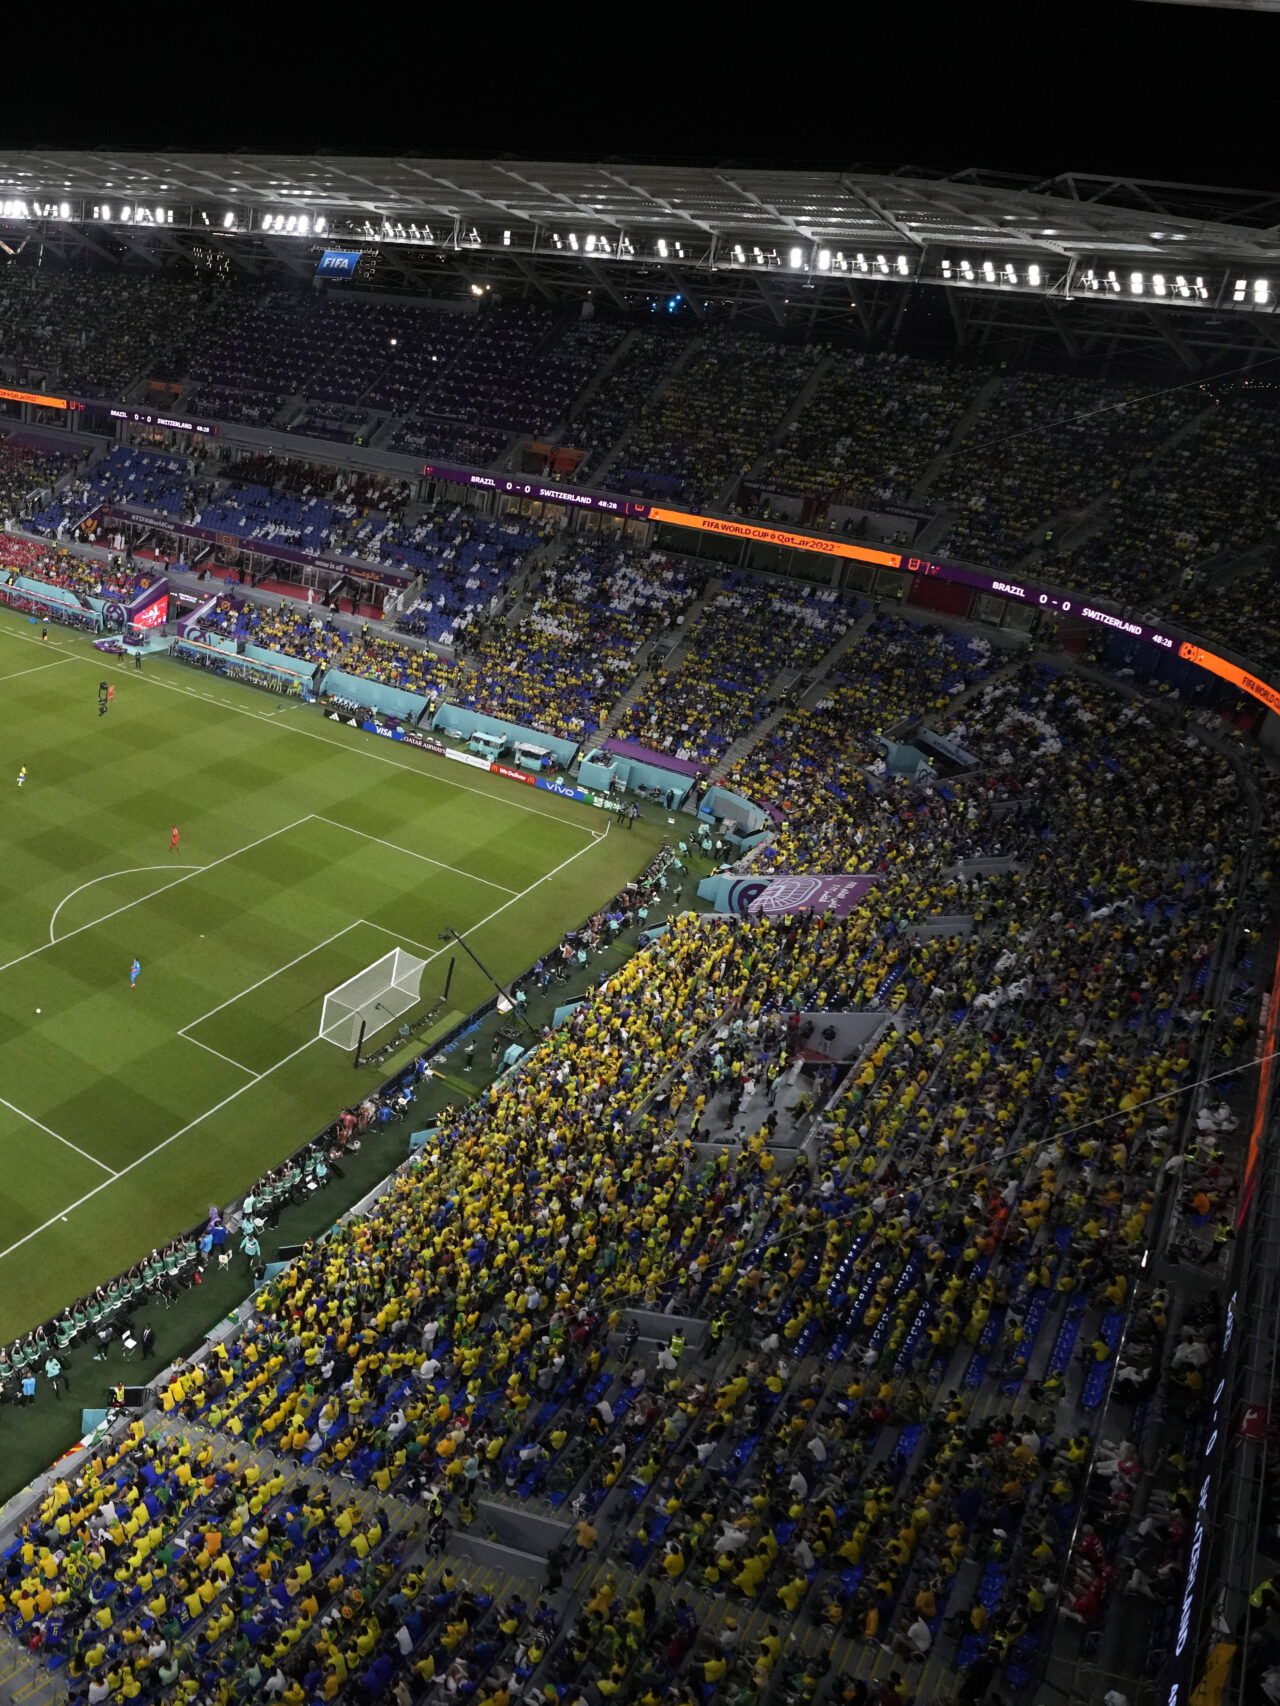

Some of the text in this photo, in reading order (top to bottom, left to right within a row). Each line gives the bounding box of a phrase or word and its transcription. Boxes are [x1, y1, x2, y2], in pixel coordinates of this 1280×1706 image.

[323, 258, 348, 268] FIFA
[111, 409, 127, 418] BRAZIL
[157, 418, 192, 429] SWITZERLAND
[471, 475, 496, 487] BRAZIL
[506, 482, 512, 490] 0
[524, 485, 531, 493] 0
[539, 488, 592, 504] SWITZERLAND
[598, 500, 617, 509] 48:28
[702, 520, 720, 530] FIFA
[721, 523, 751, 536] WORLD
[752, 530, 769, 539] CUP
[992, 581, 1025, 597] BRAZIL
[1039, 594, 1047, 604] 0
[1062, 602, 1071, 611] 0
[1081, 607, 1142, 635] SWITZERLAND
[1242, 676, 1256, 691] FIFA
[1255, 684, 1275, 703] WORLD
[376, 726, 392, 738] VISA
[403, 736, 446, 754] QATAR AIRWAYS
[507, 769, 526, 781] Deliver
[546, 782, 575, 797] vivo
